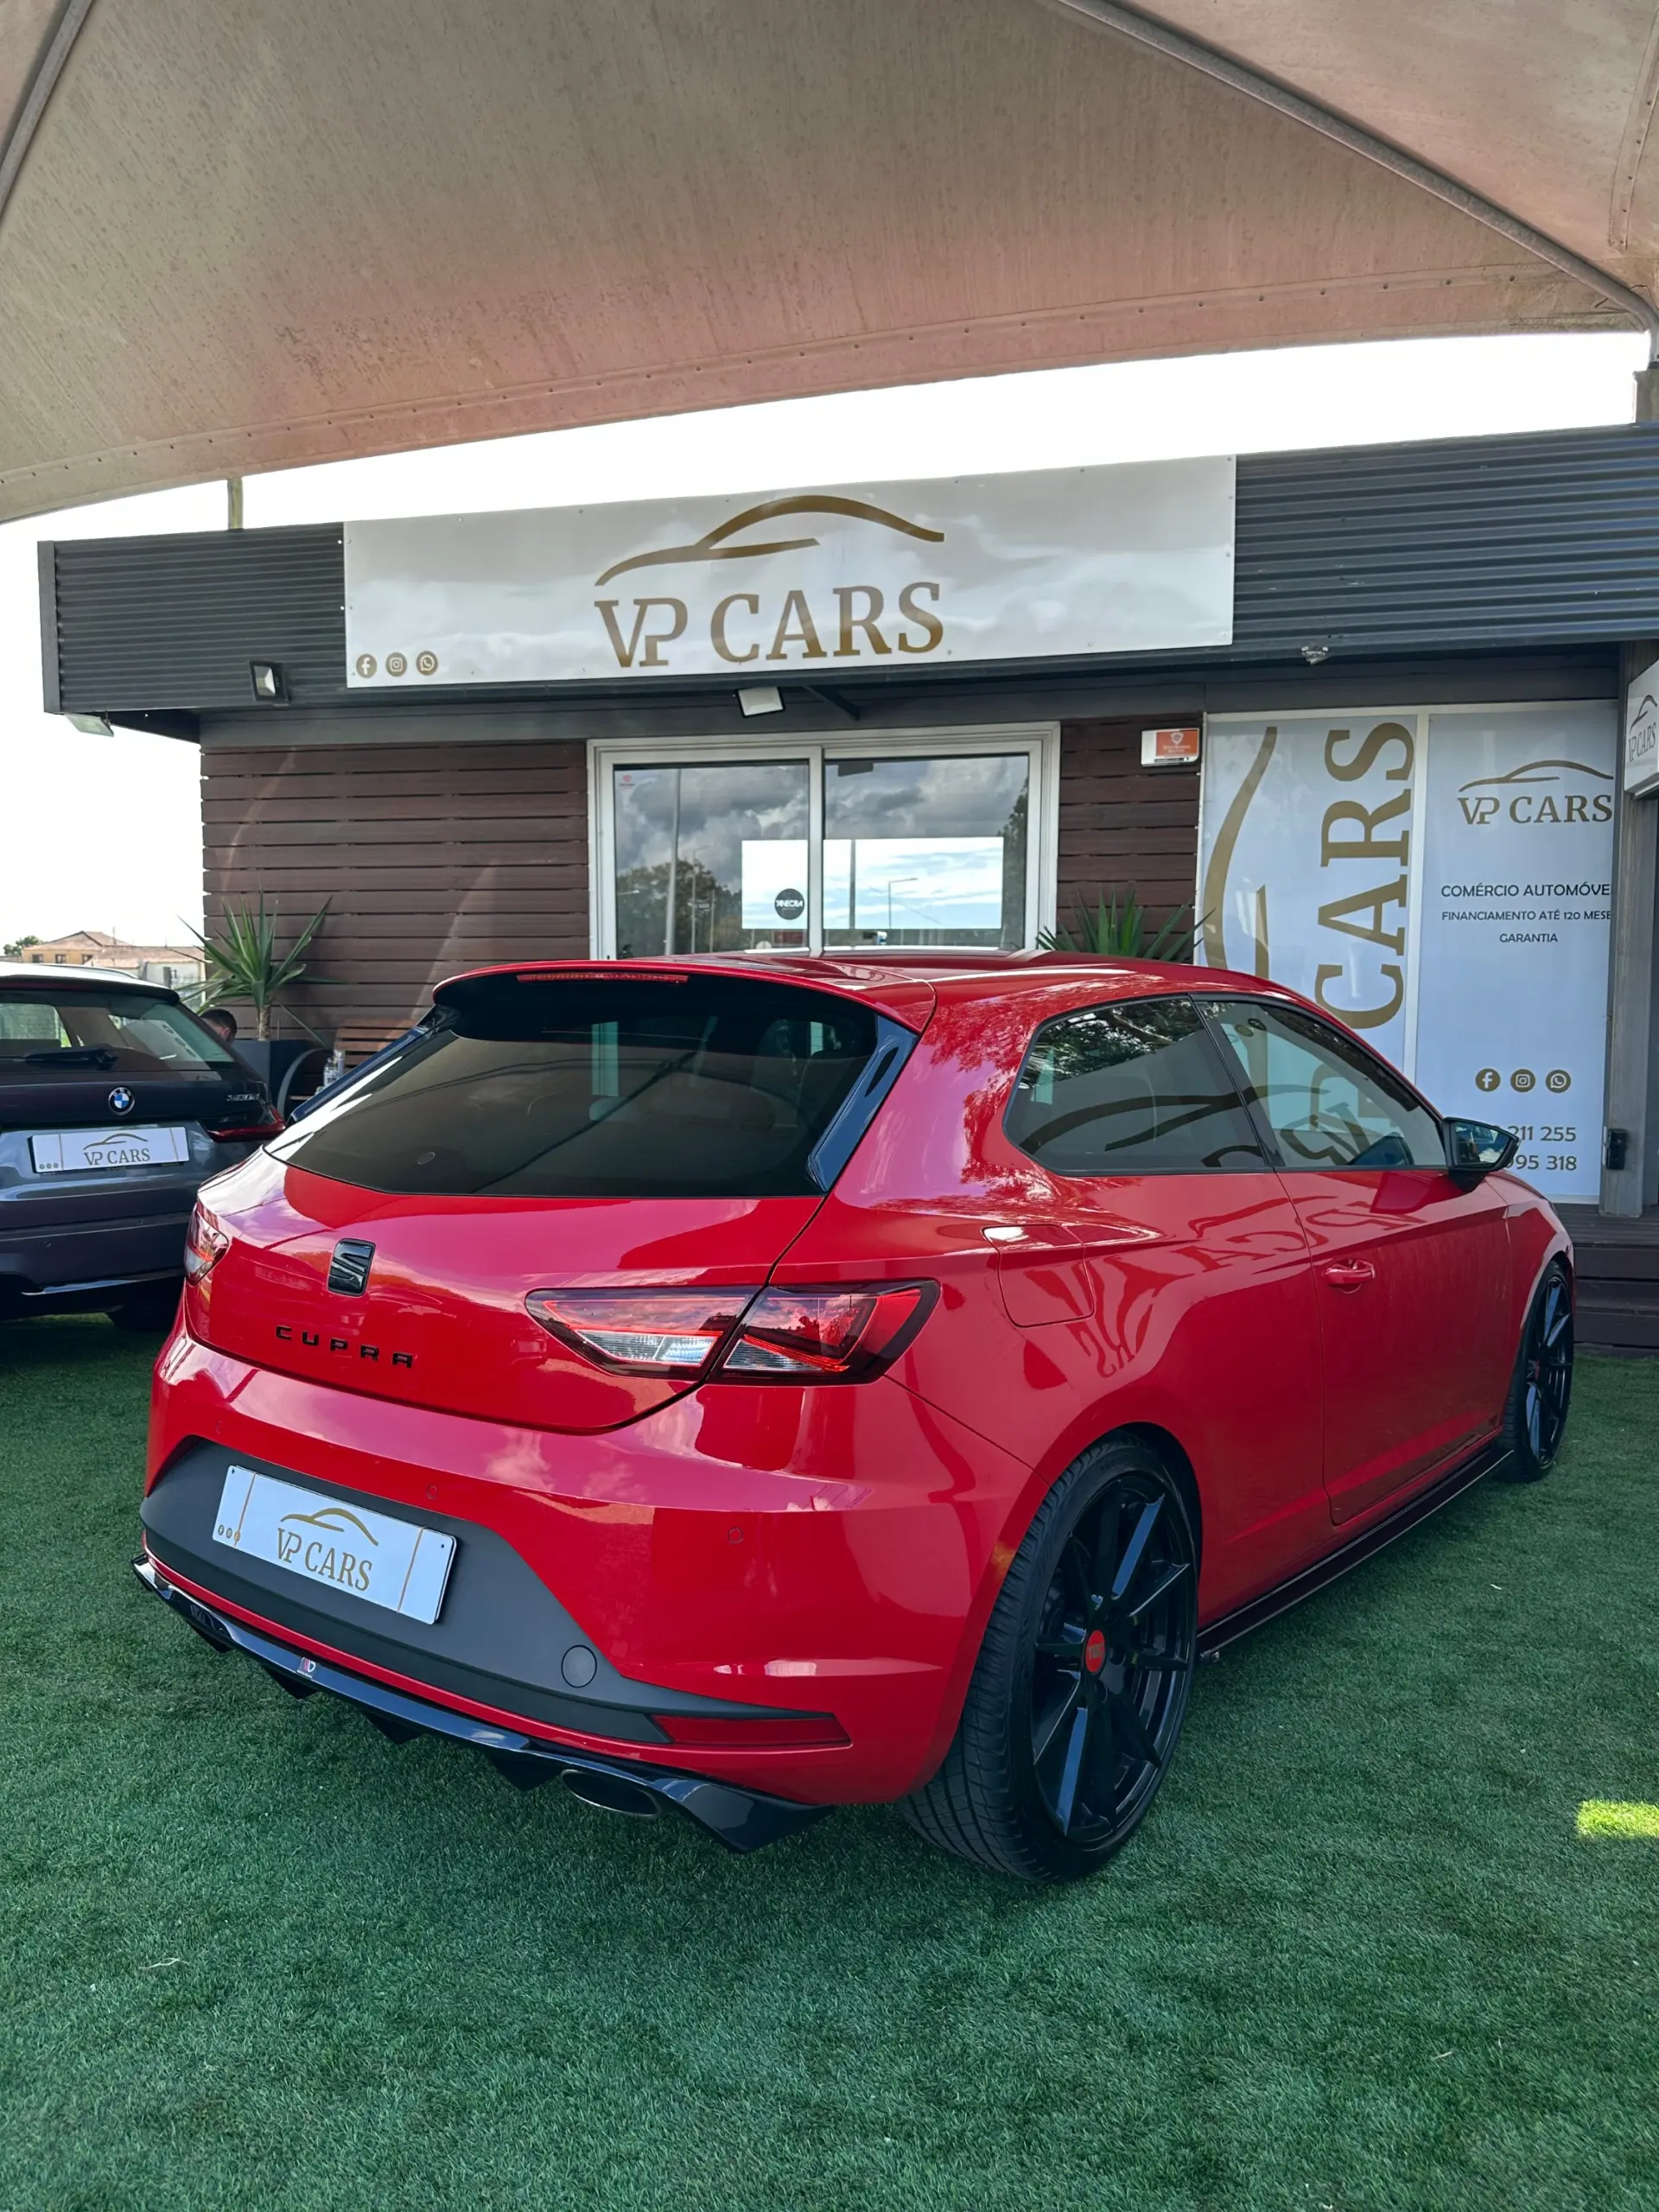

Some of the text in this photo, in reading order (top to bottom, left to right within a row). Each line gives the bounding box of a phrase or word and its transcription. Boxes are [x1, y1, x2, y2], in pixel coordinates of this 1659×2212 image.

[594, 582, 944, 668] VP CARS
[1637, 721, 1656, 757] CARS
[1457, 794, 1613, 825] VP CARS
[1314, 722, 1415, 1030] CARS
[1440, 882, 1519, 897] COMÉRCIO
[1441, 911, 1536, 921] FINANCIAMENTO
[1538, 909, 1560, 920] ATÉ
[1563, 912, 1581, 920] 120
[1499, 933, 1559, 943] GARANTIA
[1540, 1126, 1577, 1142] 255
[83, 1147, 150, 1166] VP CARS
[1546, 1155, 1577, 1171] 318
[276, 1325, 413, 1369] CUPRA
[277, 1527, 373, 1592] VP CARS
